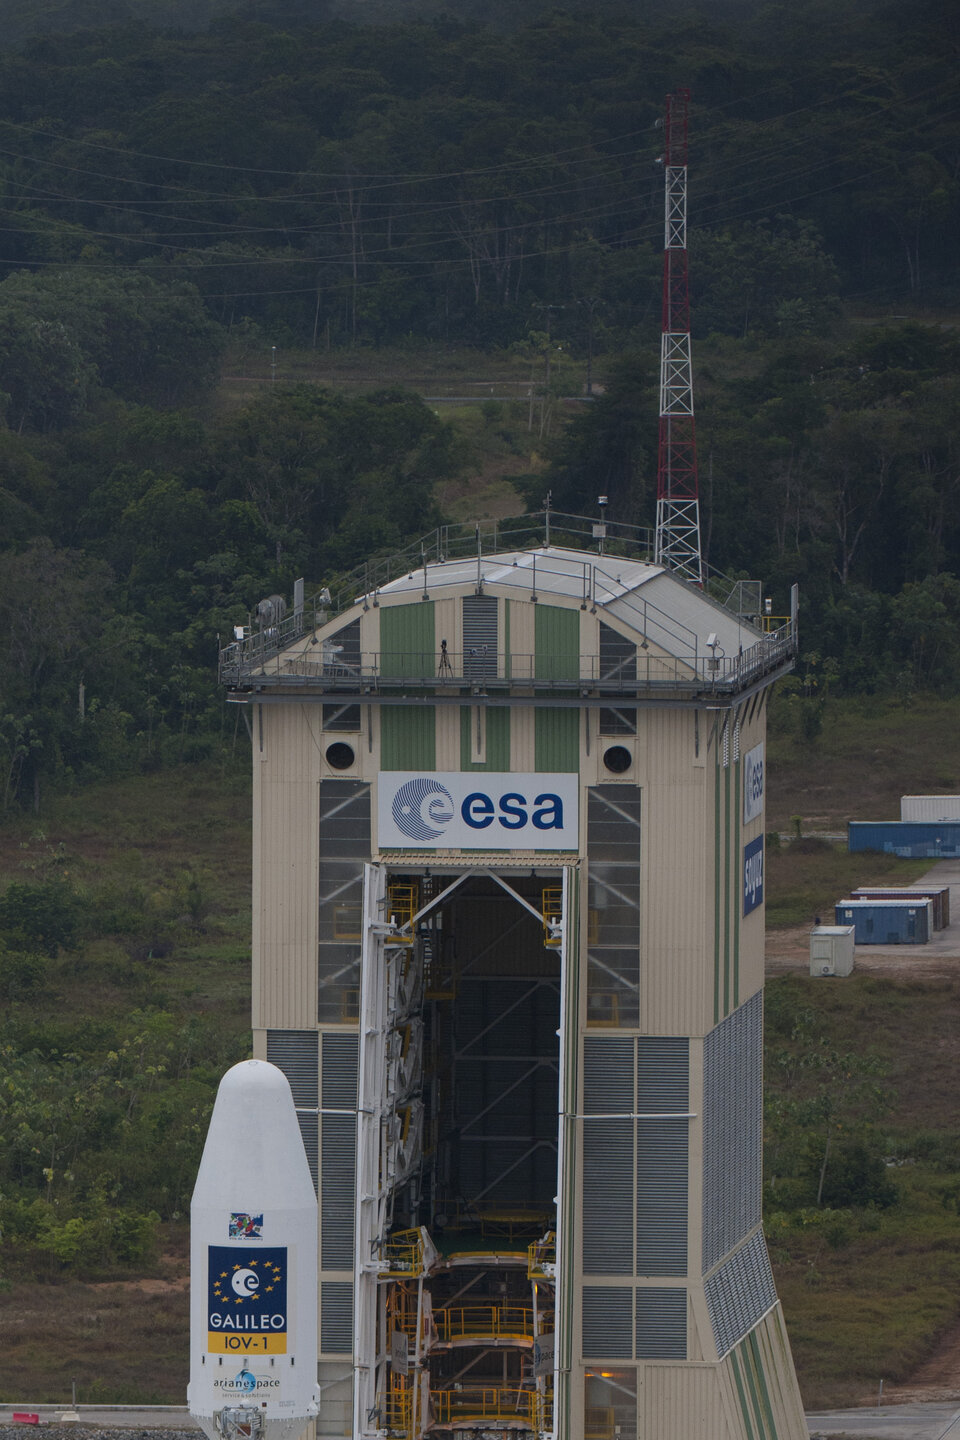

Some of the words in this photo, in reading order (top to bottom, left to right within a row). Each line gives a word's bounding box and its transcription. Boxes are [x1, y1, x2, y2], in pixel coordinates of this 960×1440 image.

[752, 760, 763, 800] esa
[461, 792, 564, 830] esa
[745, 850, 762, 904] soyuz
[210, 1312, 285, 1329] GALILEO
[213, 1377, 280, 1389] arianespace
